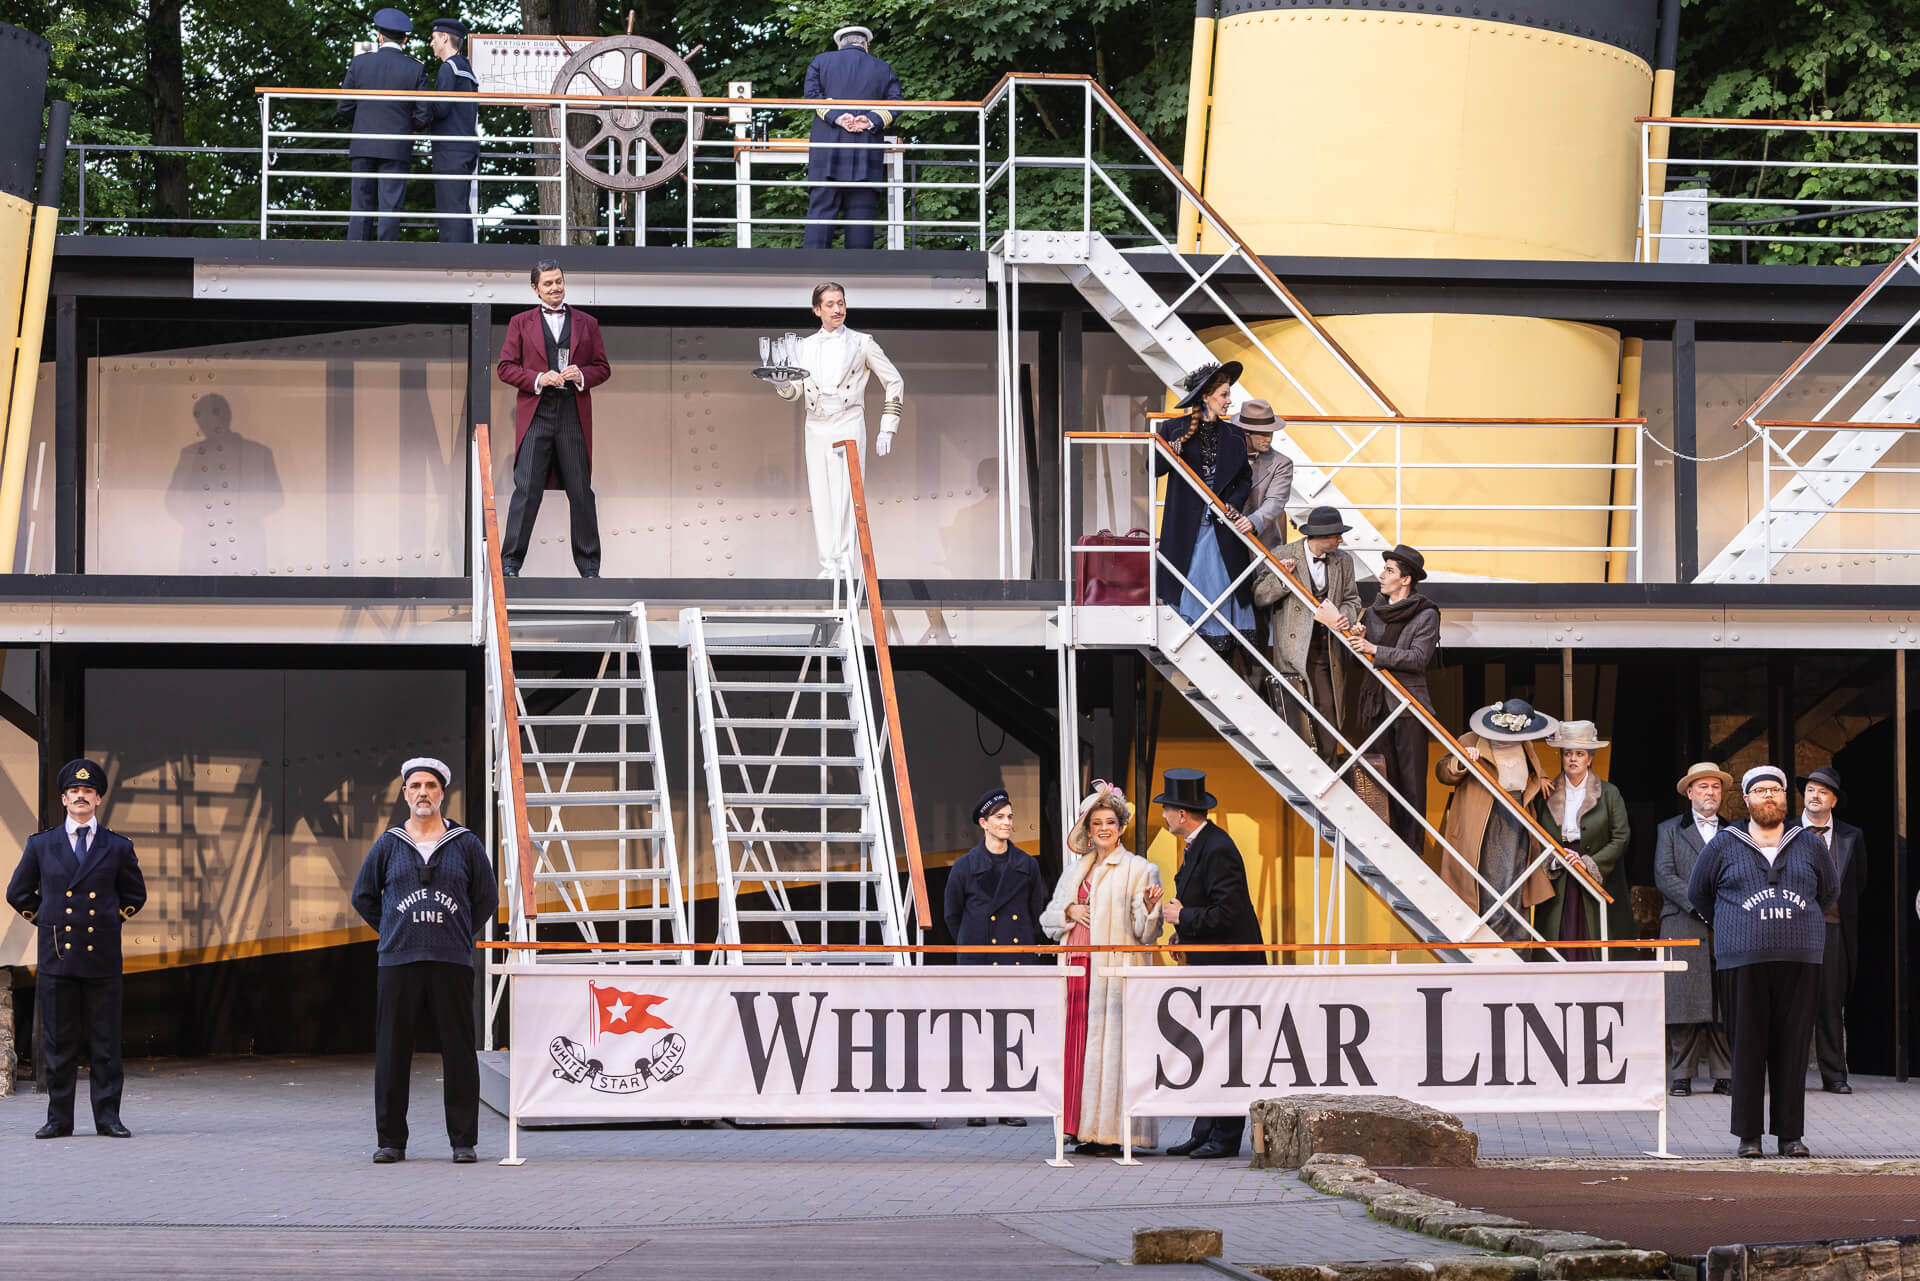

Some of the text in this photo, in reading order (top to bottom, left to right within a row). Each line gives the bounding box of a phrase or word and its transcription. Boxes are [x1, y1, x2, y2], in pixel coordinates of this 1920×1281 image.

[396, 888, 458, 915] WHITE STAR
[1742, 887, 1807, 912] WHITE STAR
[412, 910, 444, 924] LINE
[1760, 907, 1793, 921] LINE
[730, 991, 1039, 1095] WHITE
[1155, 985, 1628, 1091] STAR LINE
[551, 1040, 682, 1090] WHITE STAR LINE
